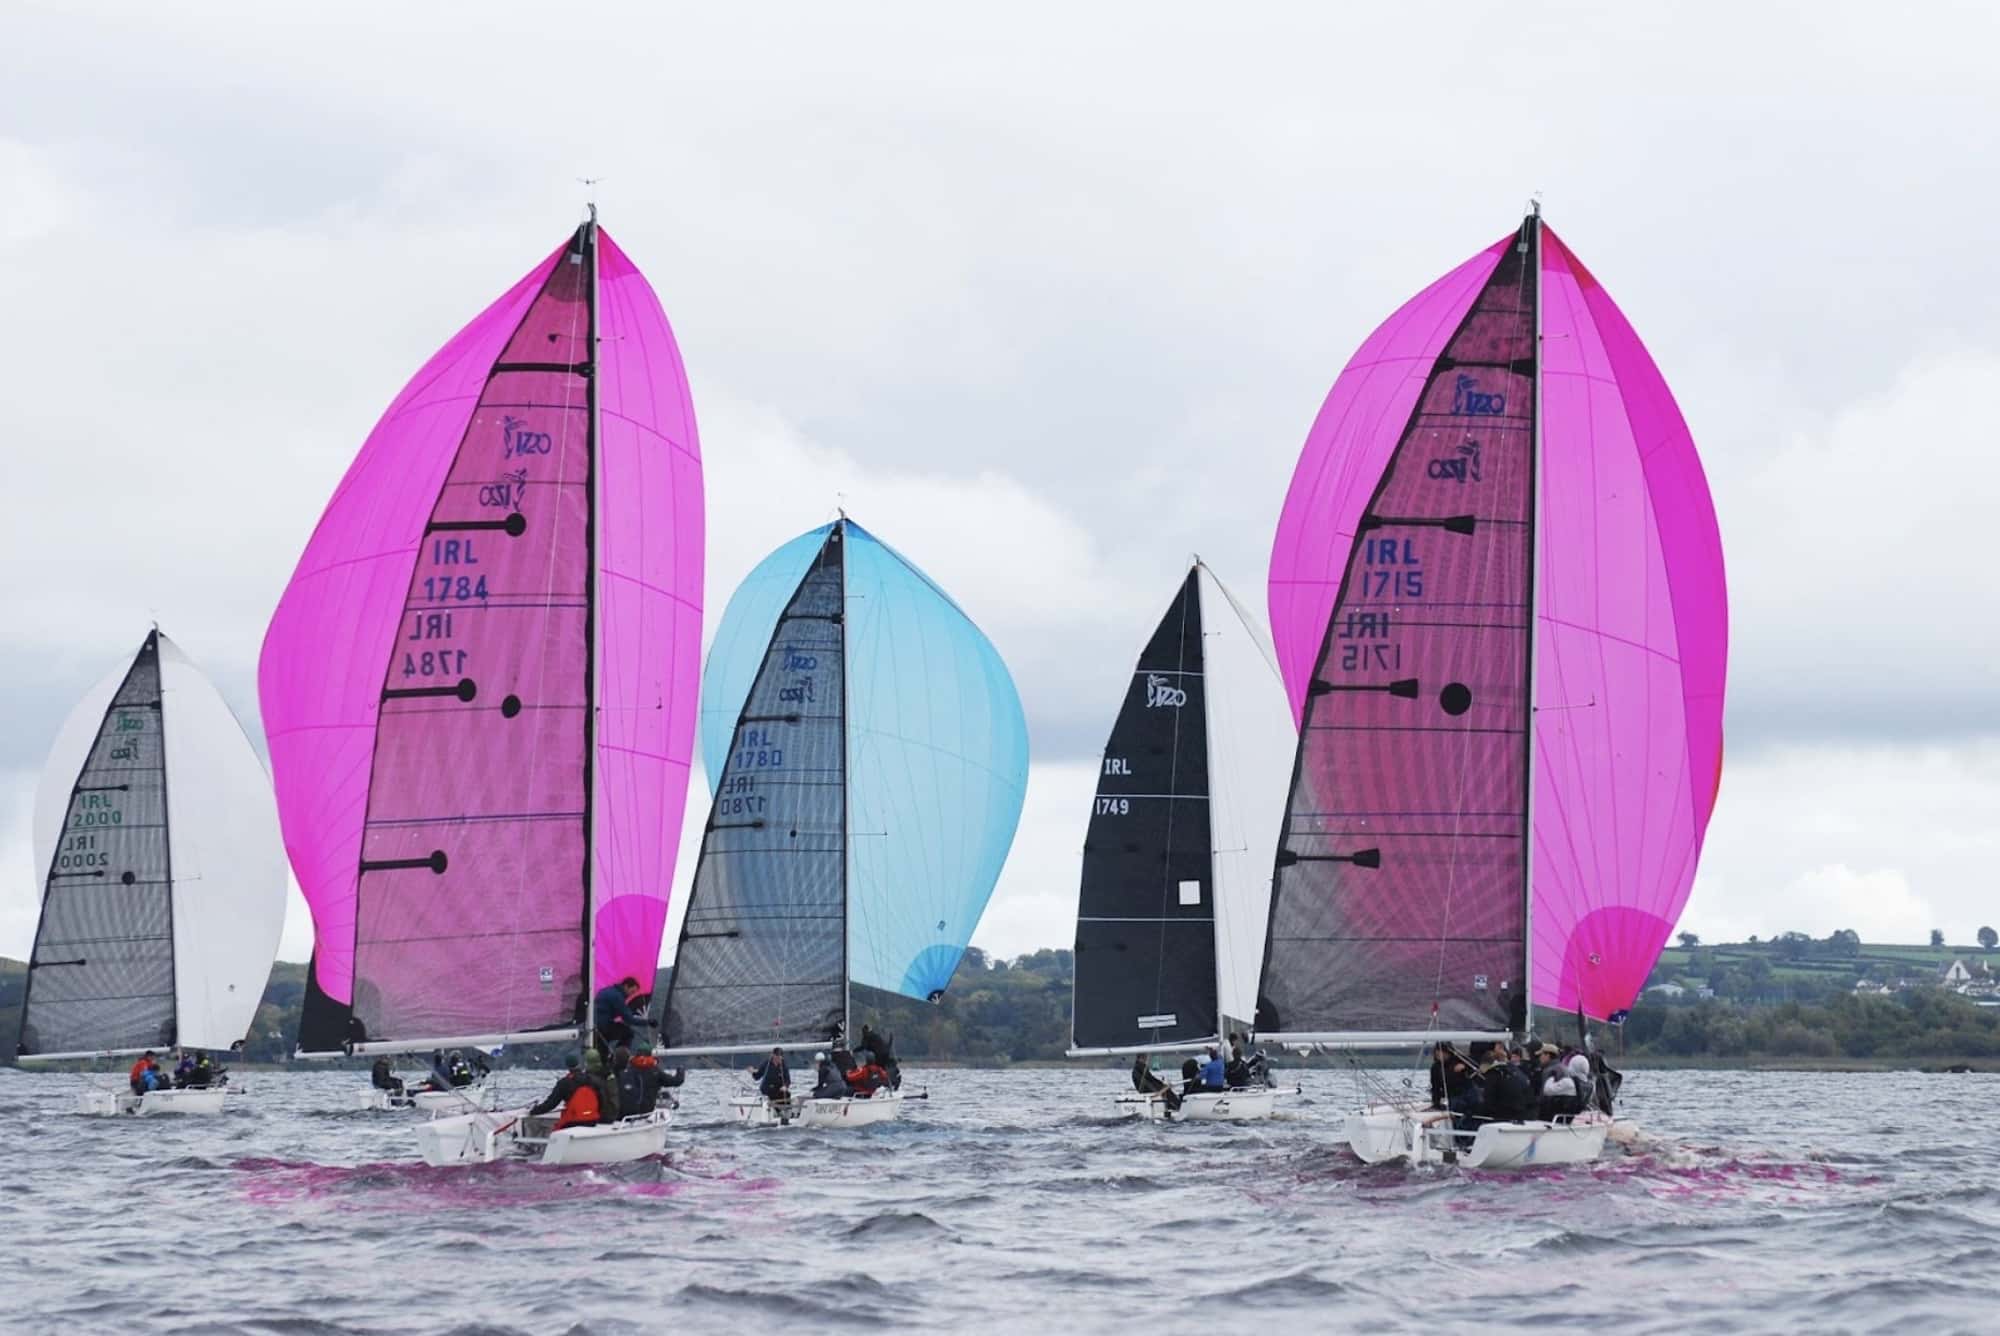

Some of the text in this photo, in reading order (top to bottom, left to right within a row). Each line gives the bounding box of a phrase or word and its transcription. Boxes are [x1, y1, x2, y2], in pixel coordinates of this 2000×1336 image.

[434, 540, 478, 565] IRL
[1365, 539, 1419, 565] IRL
[424, 575, 489, 602] 1784
[1363, 572, 1423, 597] 1715
[741, 731, 772, 748] IRL
[736, 750, 782, 768] 1780
[1105, 758, 1132, 774] IRL
[81, 795, 112, 809] IRL
[1096, 799, 1129, 815] 1749
[73, 811, 122, 827] 2000
